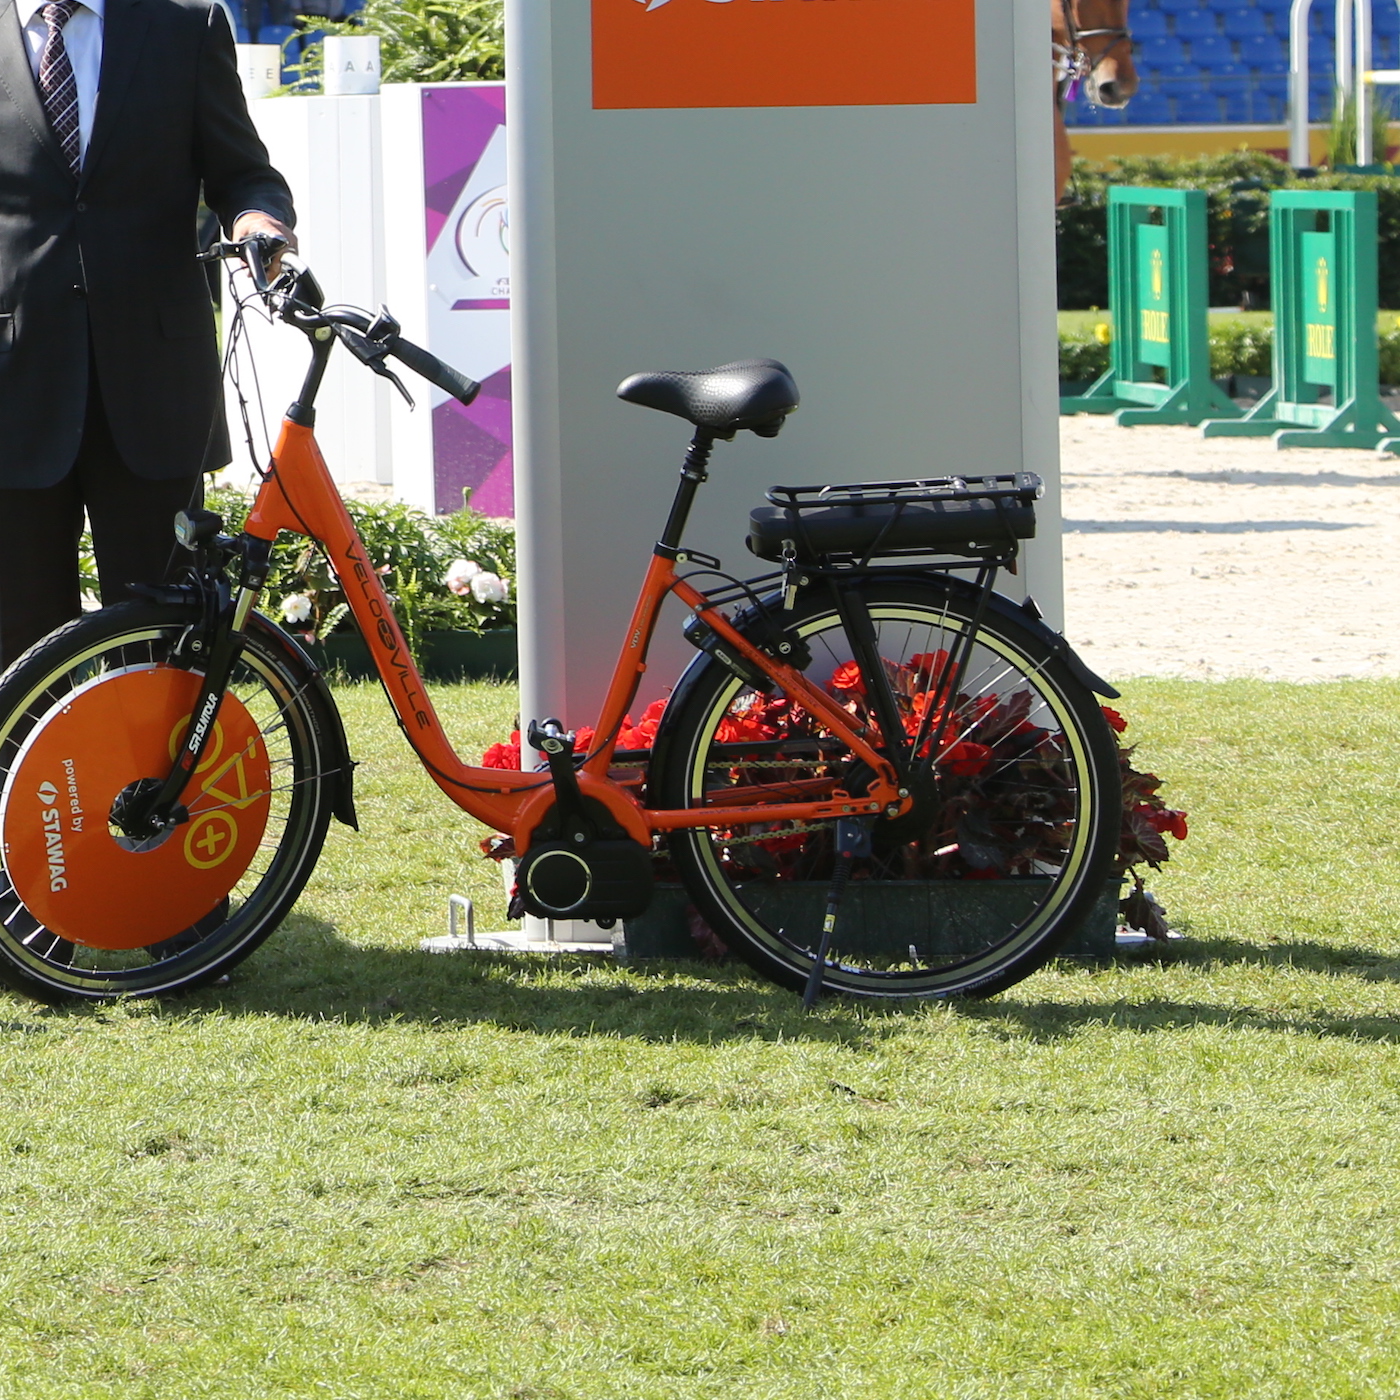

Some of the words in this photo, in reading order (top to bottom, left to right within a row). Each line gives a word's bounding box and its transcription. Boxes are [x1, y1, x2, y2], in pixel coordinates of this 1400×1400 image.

[266, 68, 274, 79] E
[345, 61, 355, 72] A
[366, 61, 375, 72] A
[1142, 310, 1169, 343] ROLE
[1306, 325, 1335, 359] ROLE
[195, 692, 218, 738] SUNTOUR
[62, 758, 83, 815] powered
[71, 816, 84, 833] by
[41, 808, 68, 892] STAWAG
